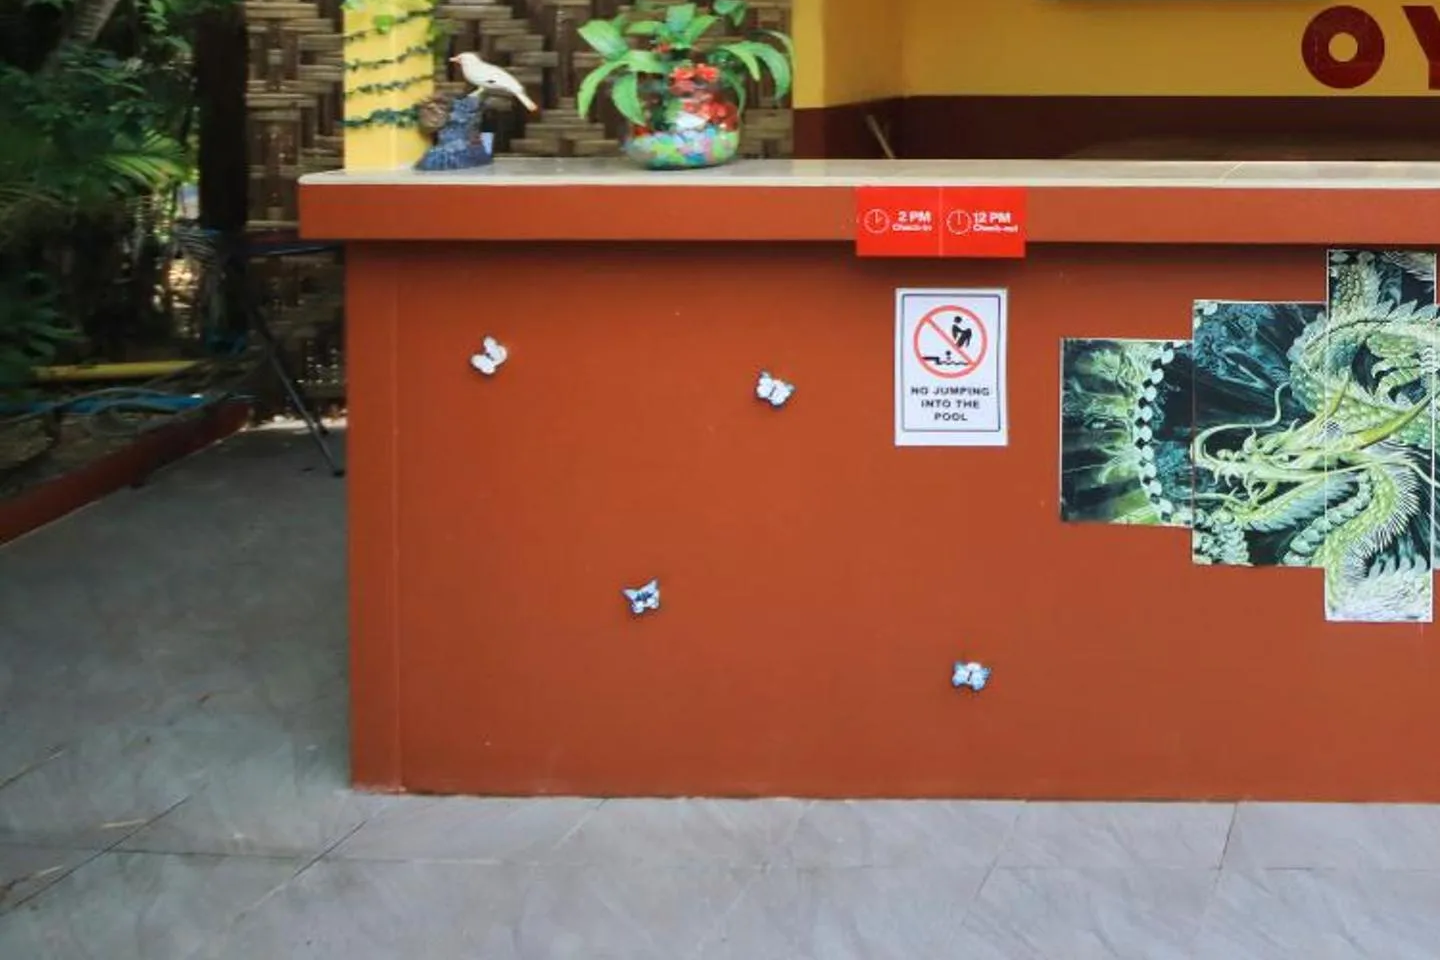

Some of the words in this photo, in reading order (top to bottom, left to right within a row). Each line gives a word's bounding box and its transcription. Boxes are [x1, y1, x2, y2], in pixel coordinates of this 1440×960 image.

[898, 210, 908, 223] 2
[909, 210, 932, 223] PM
[973, 211, 987, 224] 12
[989, 211, 1011, 224] PM
[911, 386, 928, 395] NO
[933, 386, 990, 396] JUMPING
[921, 399, 951, 408] INTO
[956, 399, 979, 409] THE
[934, 412, 968, 422] POOL
